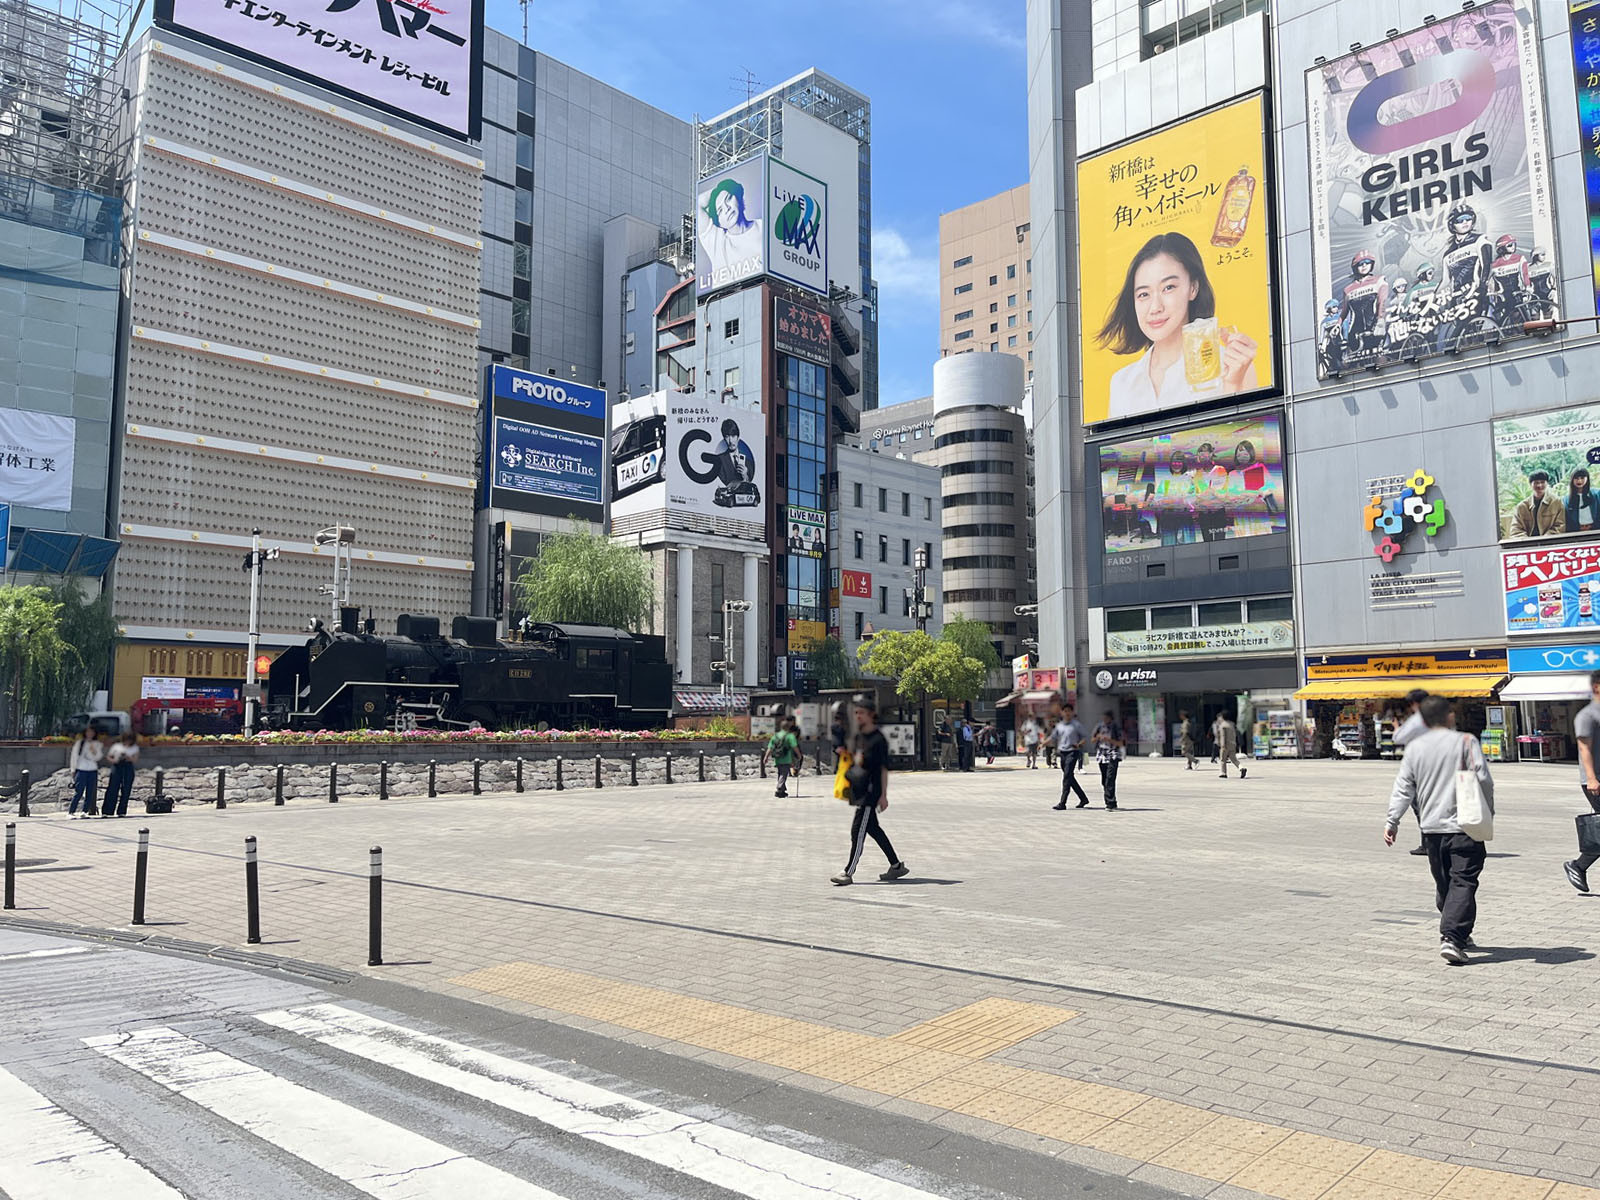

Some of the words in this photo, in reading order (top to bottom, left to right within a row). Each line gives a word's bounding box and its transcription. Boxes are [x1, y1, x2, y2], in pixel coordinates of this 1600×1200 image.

[380, 55, 451, 96] レジャービル
[1108, 156, 1156, 183] 新橋は
[1360, 132, 1490, 193] GIRLS
[1135, 164, 1198, 200] 幸せの
[1112, 182, 1222, 232] 角ハイボール
[1362, 165, 1494, 227] KEIRIN
[782, 209, 821, 260] MAX
[783, 249, 820, 272] GROUP
[778, 317, 828, 345] 始めました
[512, 376, 567, 404] PROTO
[566, 396, 591, 409] グループ
[671, 407, 710, 415] 新橋のみなさん
[502, 423, 518, 432] Digital
[531, 428, 539, 436] AD
[540, 431, 557, 440] Network
[559, 435, 582, 446] Connecting
[525, 453, 573, 472] SEARCH
[577, 462, 597, 477] Inc.
[621, 464, 638, 483] TAXI
[642, 453, 657, 474] GO
[807, 512, 825, 524] MAX
[1107, 556, 1132, 566] FARO
[1133, 554, 1152, 564] CITY
[1519, 557, 1600, 582] ヘパリー
[1117, 671, 1130, 681] LA
[1314, 667, 1346, 675] Matsumoto
